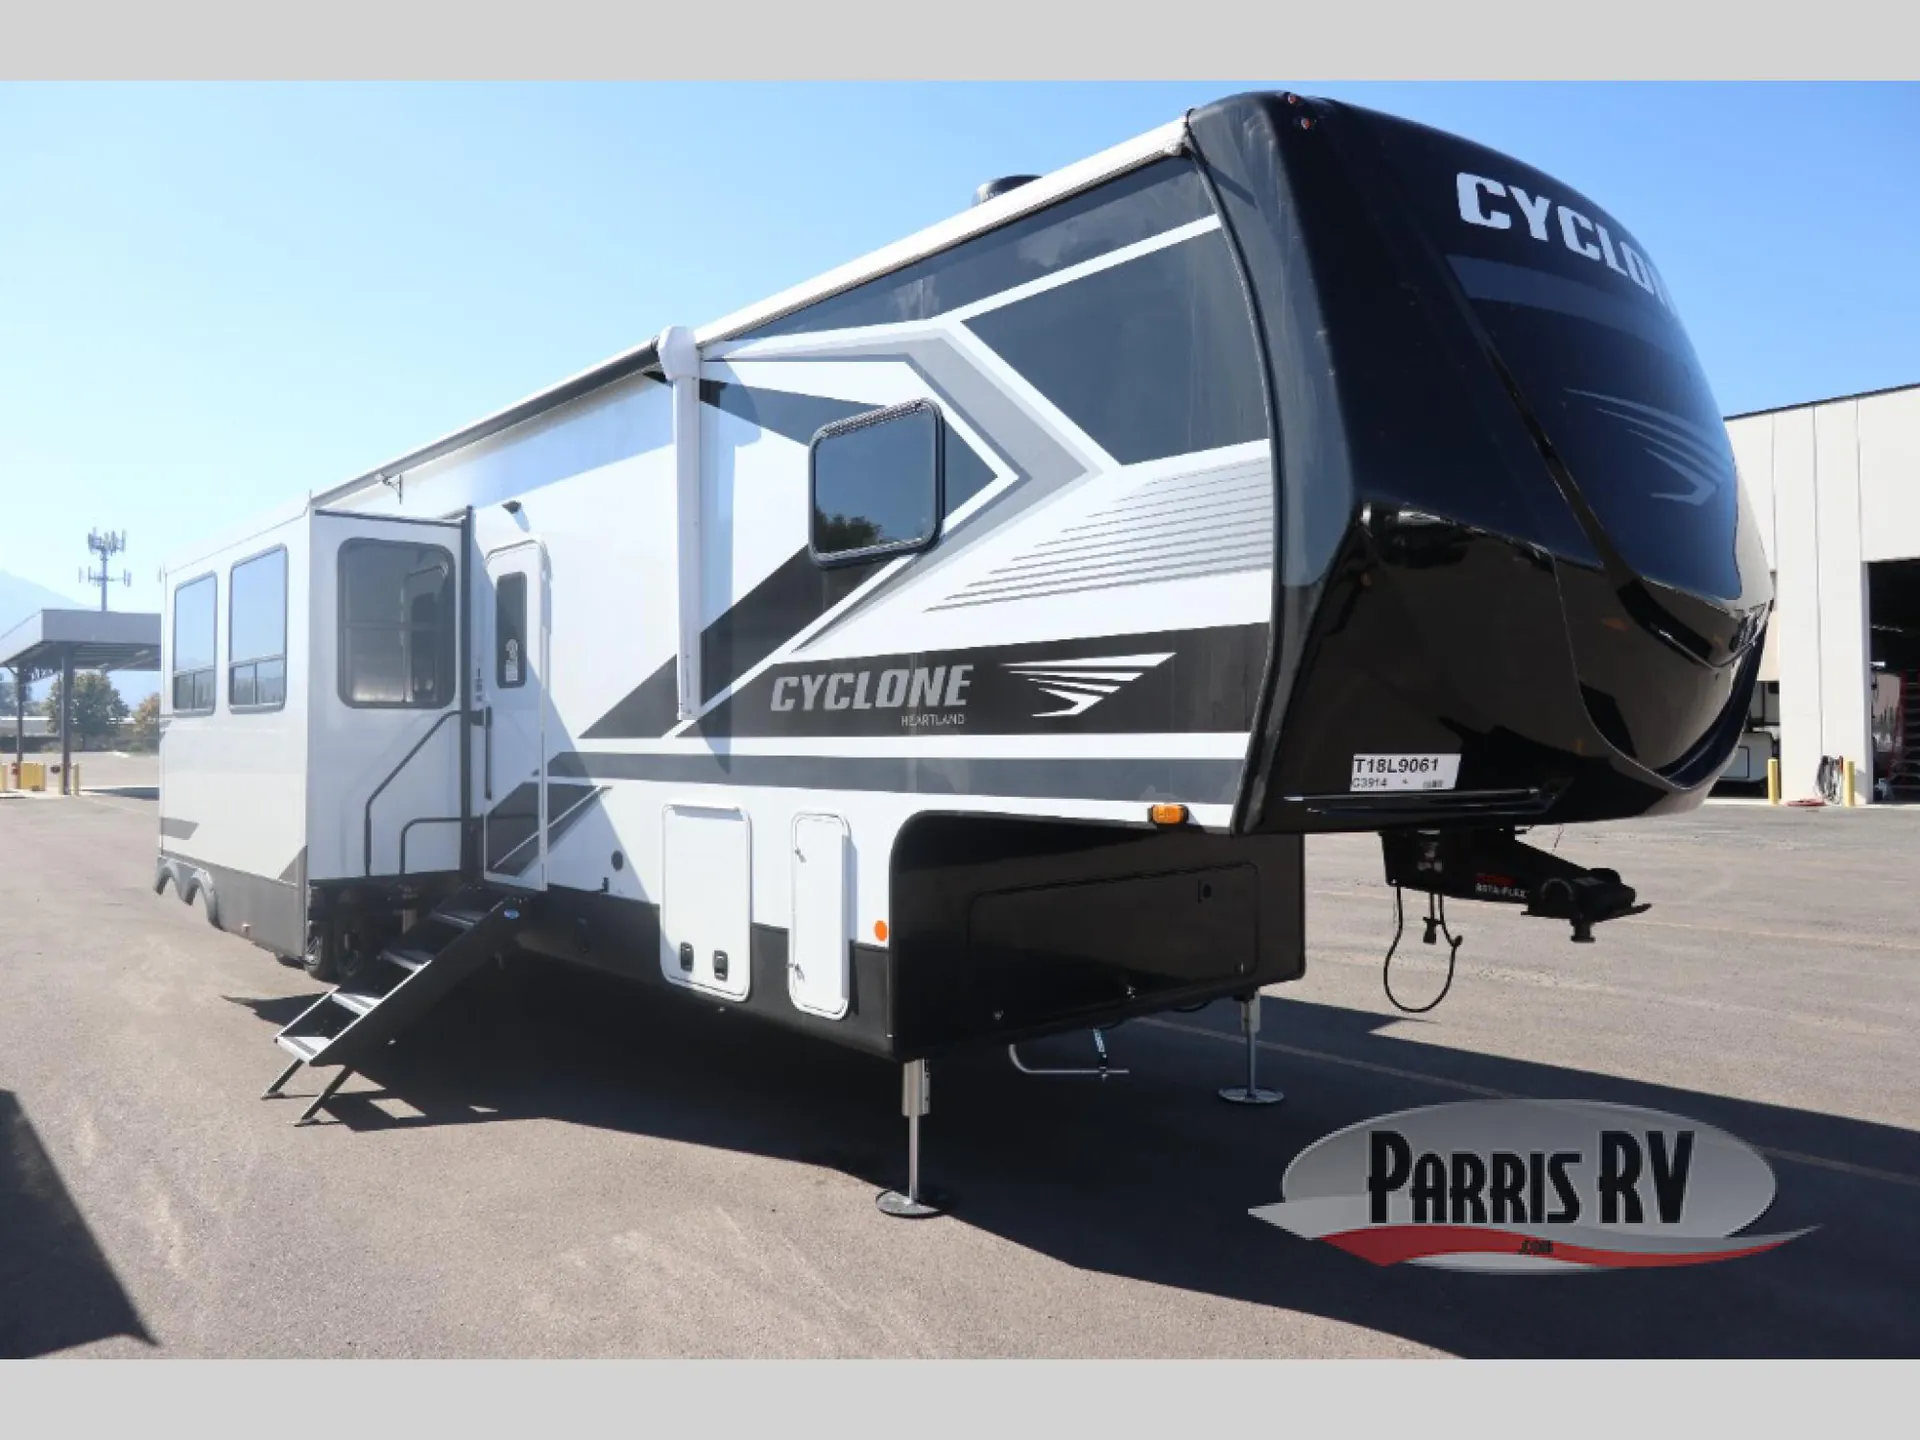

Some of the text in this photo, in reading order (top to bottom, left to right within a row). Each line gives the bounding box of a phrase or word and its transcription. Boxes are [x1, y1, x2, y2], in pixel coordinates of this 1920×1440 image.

[1456, 172, 1676, 312] CYCLON
[770, 664, 974, 711] CYCLONE
[901, 713, 965, 726] HEARTLAND
[1354, 757, 1439, 773] T18L9061
